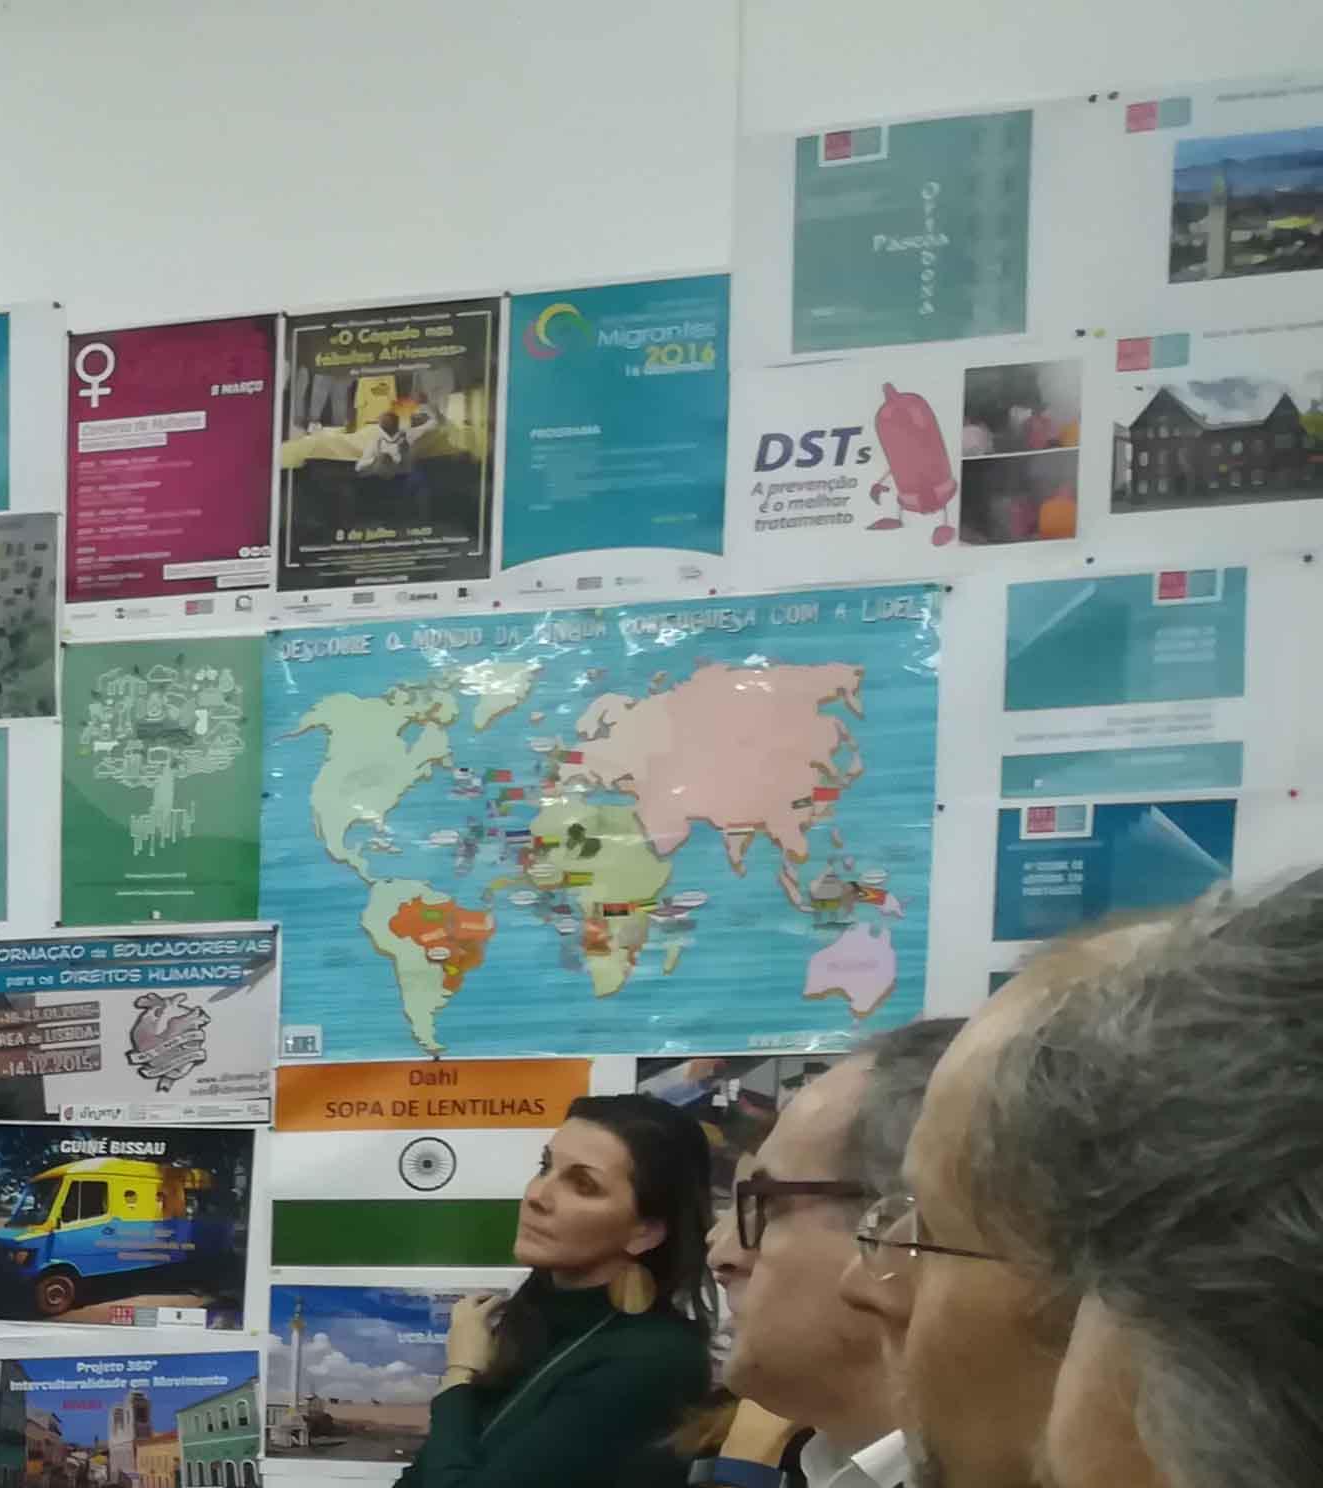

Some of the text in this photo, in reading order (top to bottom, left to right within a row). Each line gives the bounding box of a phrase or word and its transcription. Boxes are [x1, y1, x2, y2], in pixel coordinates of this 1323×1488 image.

[597, 320, 716, 350] Migrantes
[644, 341, 716, 369] 2016
[753, 426, 872, 473] DSTs
[751, 475, 859, 499] A prevenção
[787, 494, 852, 511] melhor
[754, 512, 854, 532] tratamento
[770, 603, 820, 626] COM
[113, 938, 274, 958] EDUCADORES/AS
[59, 967, 142, 985] DIREITOS
[148, 963, 243, 982] HUMANOS
[324, 1097, 546, 1119] SOPA DE LENTILHAS
[109, 1140, 167, 1156] BISSAU
[75, 1360, 125, 1376] Projeto
[9, 1376, 127, 1392] Interculturalidade
[152, 1375, 229, 1388] Movimento
